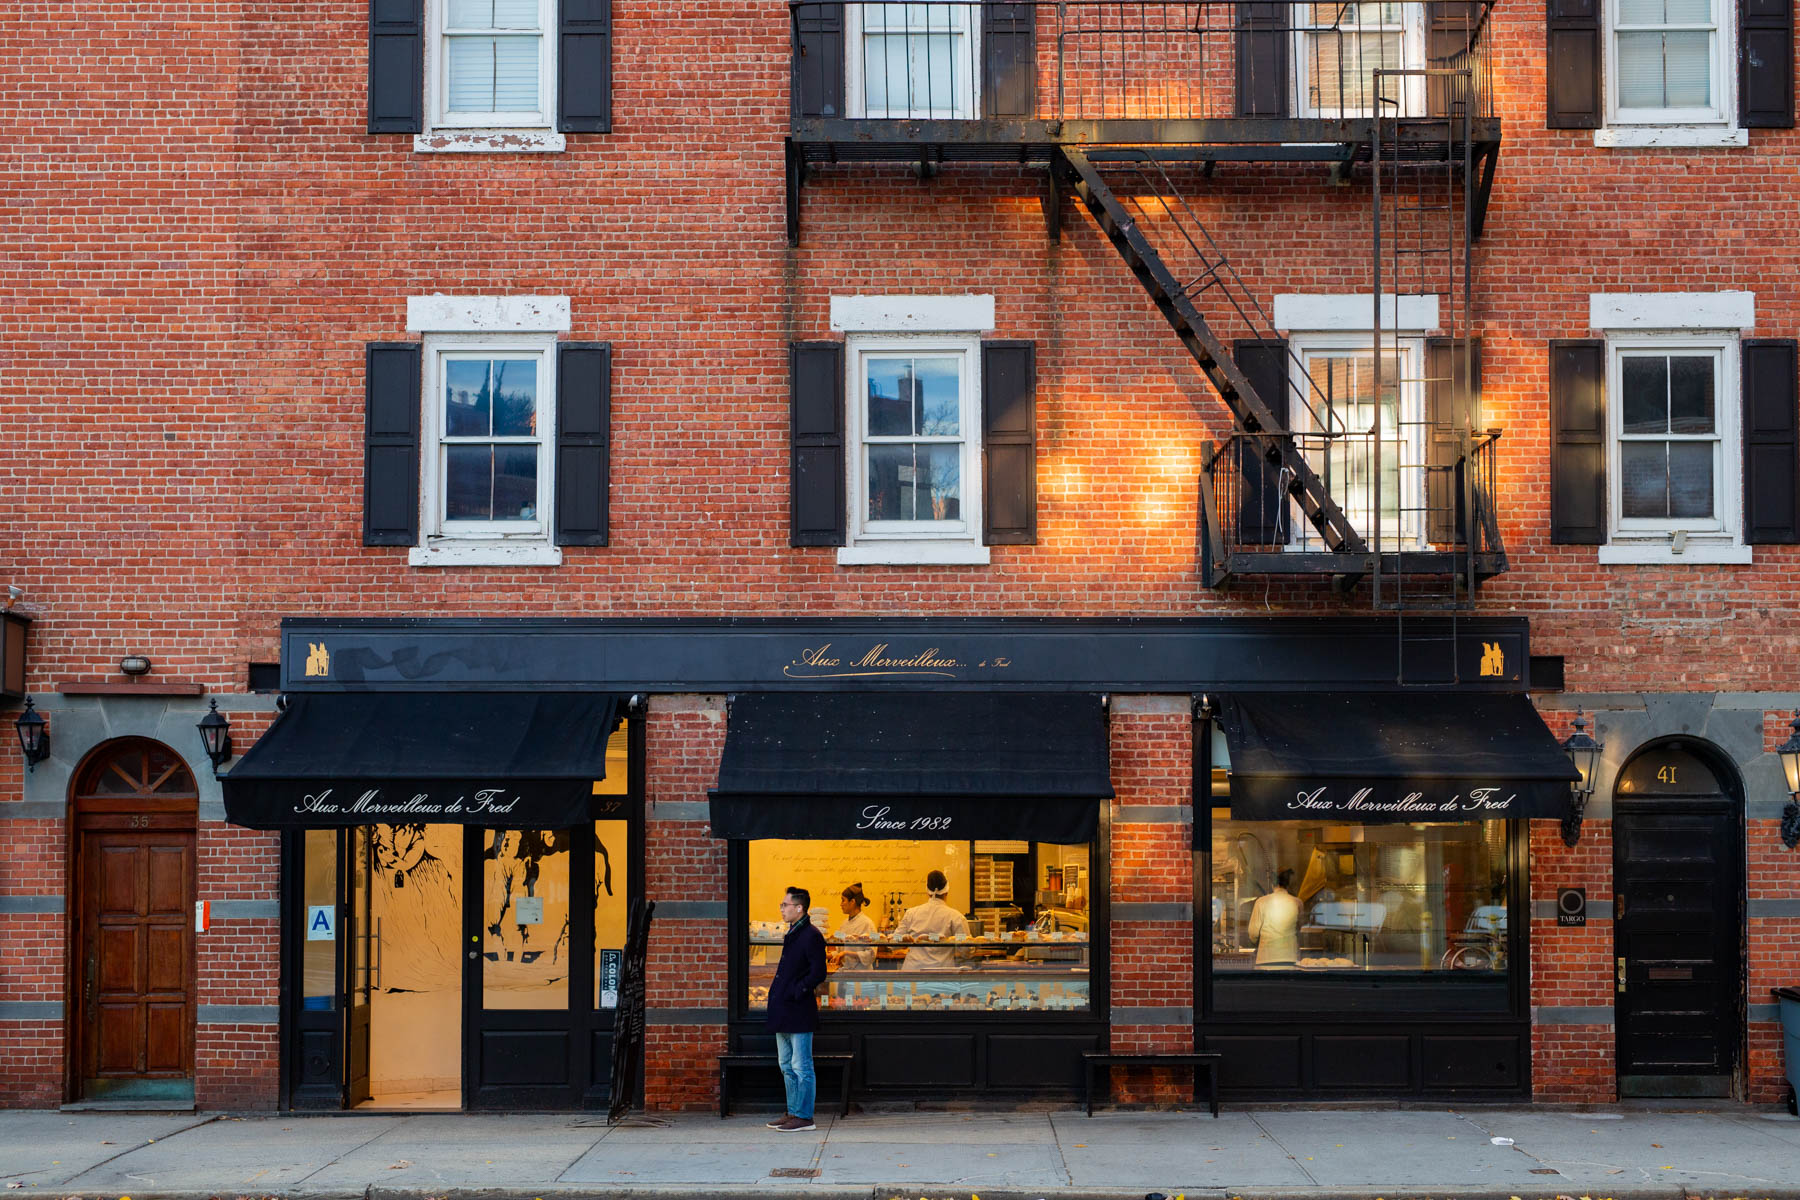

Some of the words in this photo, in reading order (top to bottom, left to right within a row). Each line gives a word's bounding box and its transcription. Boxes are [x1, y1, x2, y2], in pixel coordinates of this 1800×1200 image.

[792, 643, 841, 668] Aux
[1657, 765, 1677, 784] 41
[293, 788, 339, 814] Aux
[341, 789, 443, 814] Merveilleux
[444, 796, 463, 814] de
[466, 788, 521, 814] Fred
[1287, 786, 1333, 810] Aux
[1336, 787, 1437, 812] Merveilleux
[1439, 793, 1458, 812] de
[1462, 787, 1517, 811] Fred
[131, 815, 149, 828] 35
[856, 805, 906, 829] Since
[910, 816, 952, 830] 1982
[311, 910, 330, 930] A
